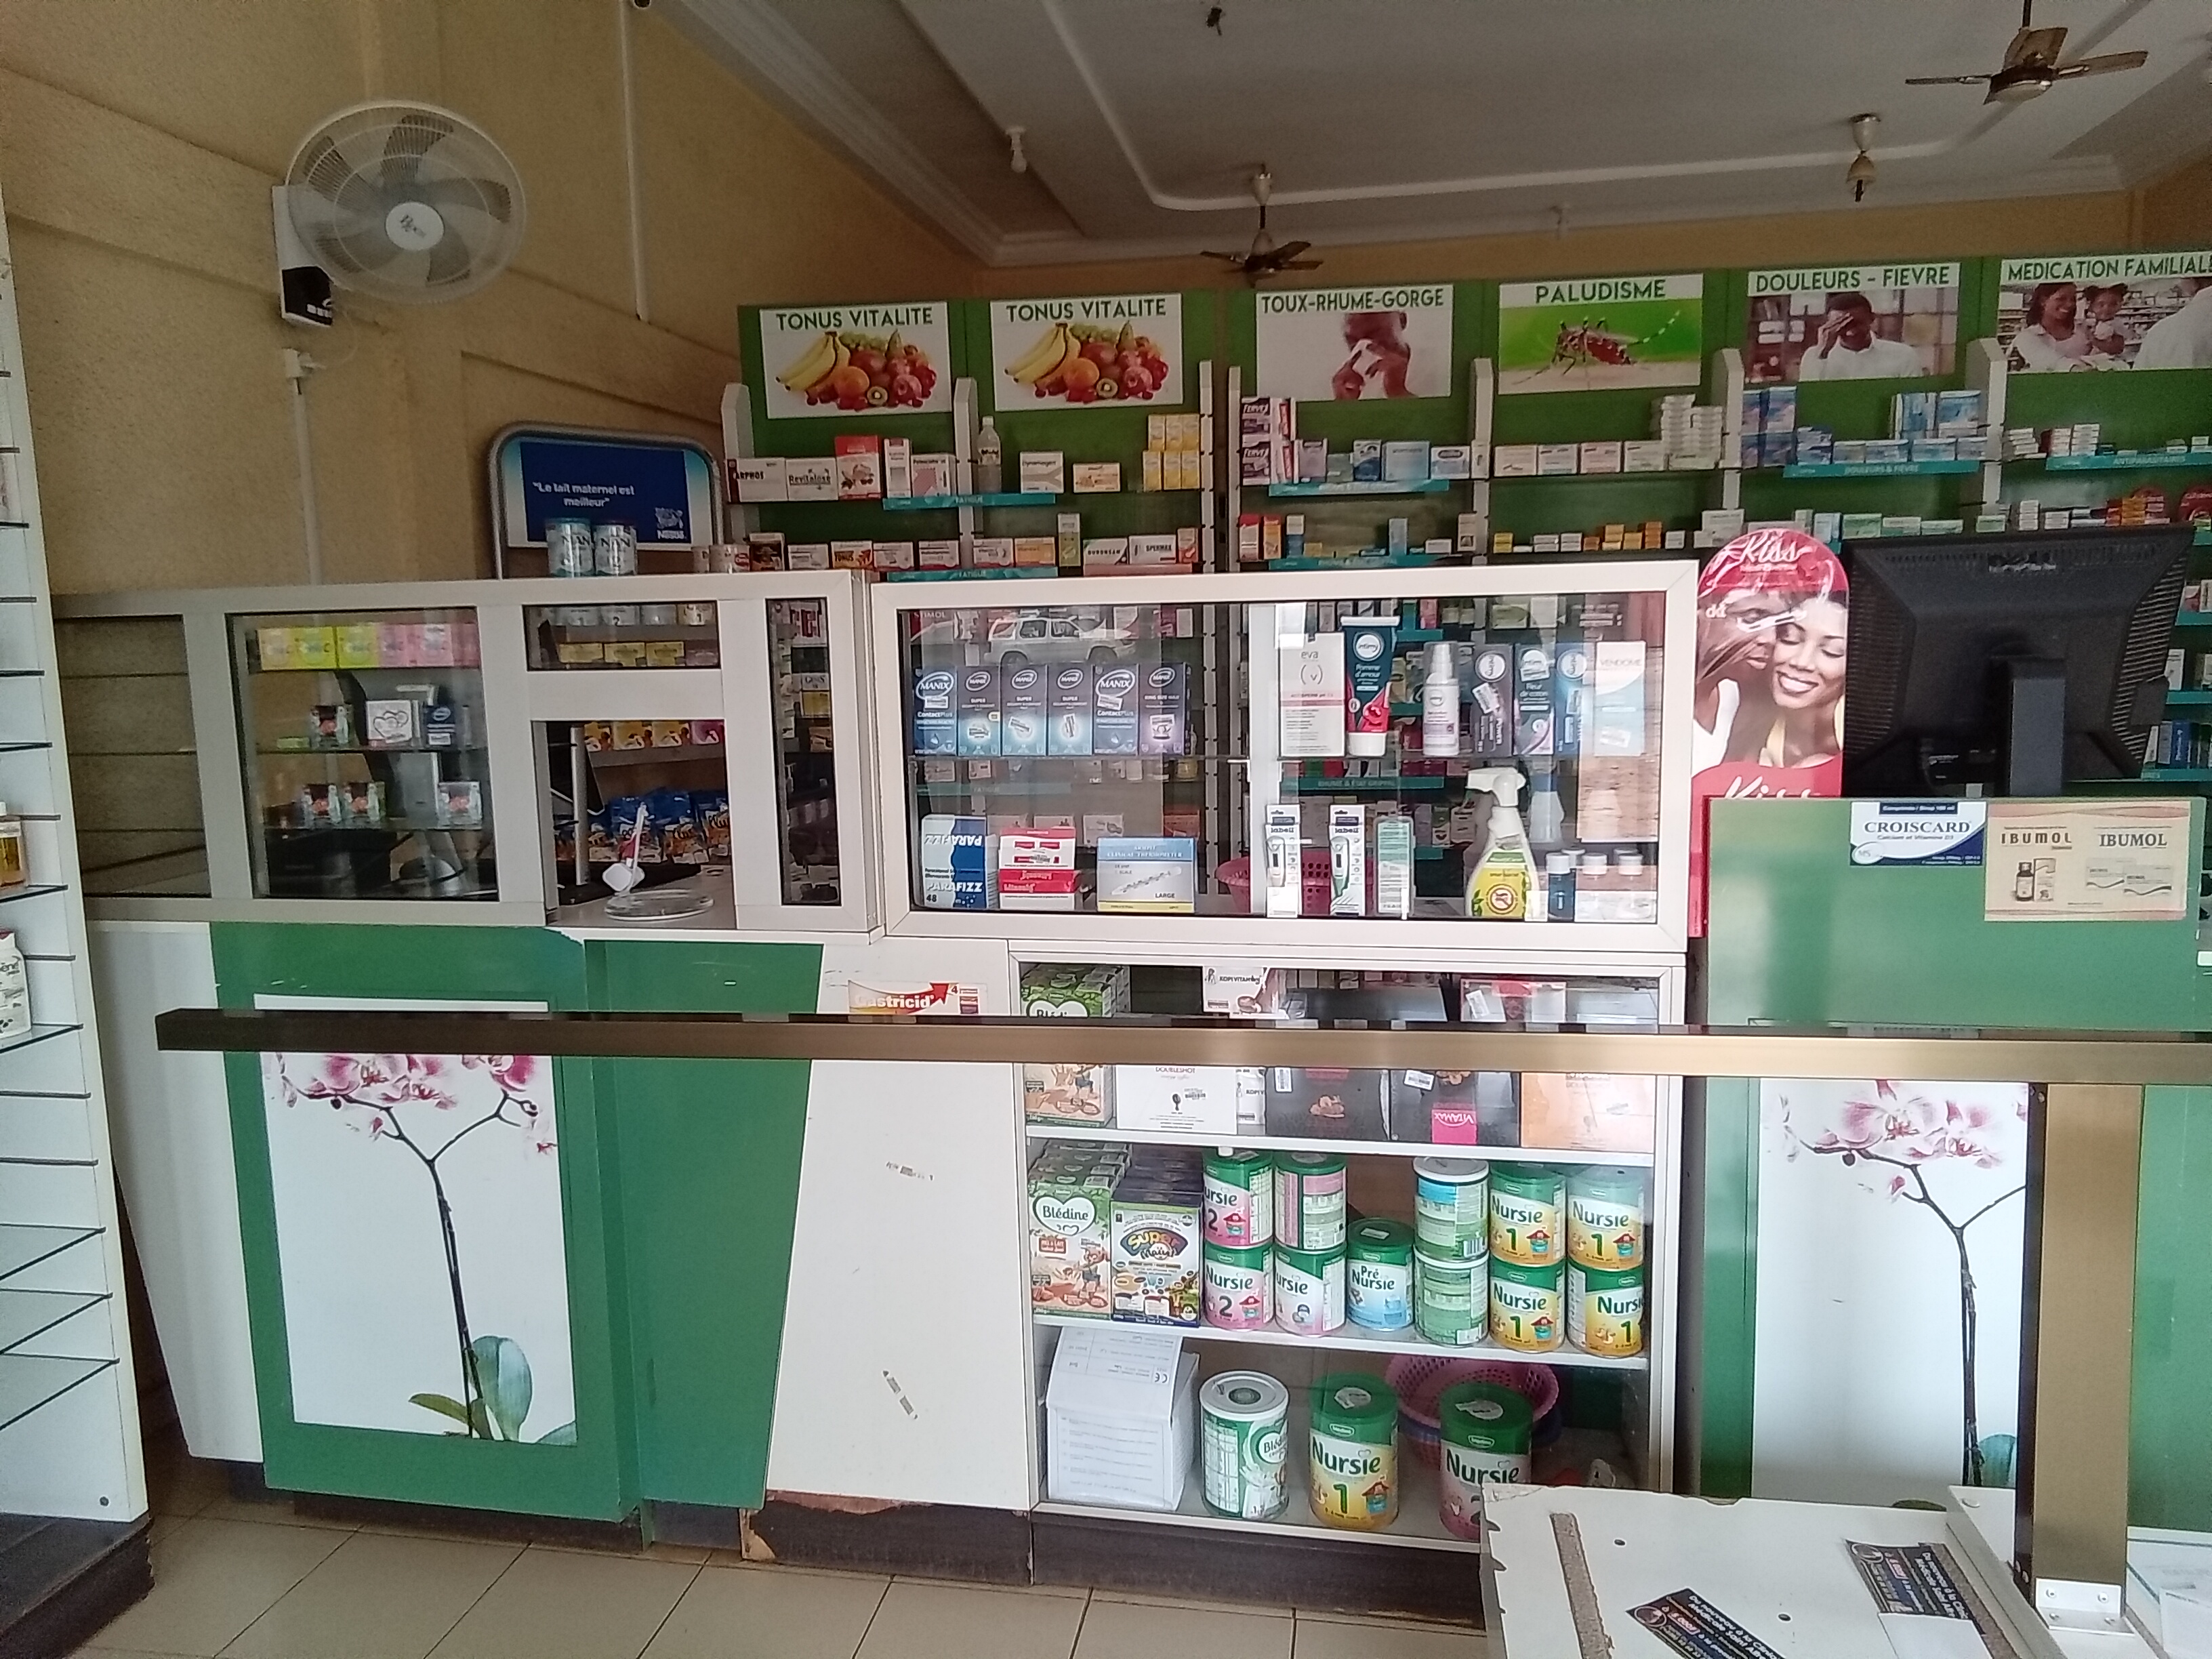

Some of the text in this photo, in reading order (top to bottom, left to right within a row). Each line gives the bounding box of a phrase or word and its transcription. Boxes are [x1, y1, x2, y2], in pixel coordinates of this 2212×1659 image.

[1756, 270, 1860, 292] DOULEURS
[1881, 266, 1950, 287] FIEVRE
[2008, 260, 2120, 281] MEDICATION
[1261, 289, 1444, 313] TOUX-RHUME-GORGE
[1536, 280, 1666, 304] PALUDISME
[776, 307, 933, 331] TONUS VITALITE
[1006, 298, 1166, 322] TONUS VITALITE
[572, 484, 617, 495] maternel
[1301, 651, 1319, 659] eva
[920, 682, 950, 691] MANIX
[1100, 680, 1131, 689] MANIX
[1864, 821, 1971, 833] CROISCARD
[924, 834, 983, 846] PARAFIZZ
[2100, 833, 2167, 847] IBUMOL
[926, 894, 937, 903] 48
[927, 882, 983, 893] PARAFIZZ
[950, 985, 958, 995] 4
[1205, 1189, 1237, 1206] ursie
[1043, 1206, 1089, 1221] Blédine
[1208, 1208, 1218, 1231] 2
[1492, 1195, 1543, 1223] Nursie
[1573, 1201, 1629, 1227] Nursie
[1506, 1228, 1517, 1251] 1
[1591, 1233, 1603, 1256] 1
[1206, 1265, 1253, 1290] Nursie
[1352, 1269, 1395, 1290] Nursie
[1361, 1265, 1379, 1279] Pré
[1276, 1273, 1308, 1295] ursie
[1219, 1295, 1233, 1317] 2
[1494, 1282, 1547, 1311] Nursie
[1597, 1295, 1643, 1314] Nursi
[1510, 1315, 1521, 1338] 1
[1621, 1320, 1632, 1343] 1
[1312, 1436, 1381, 1475] Nursie
[1446, 1448, 1519, 1484] Nursie
[1333, 1483, 1349, 1514] 1
